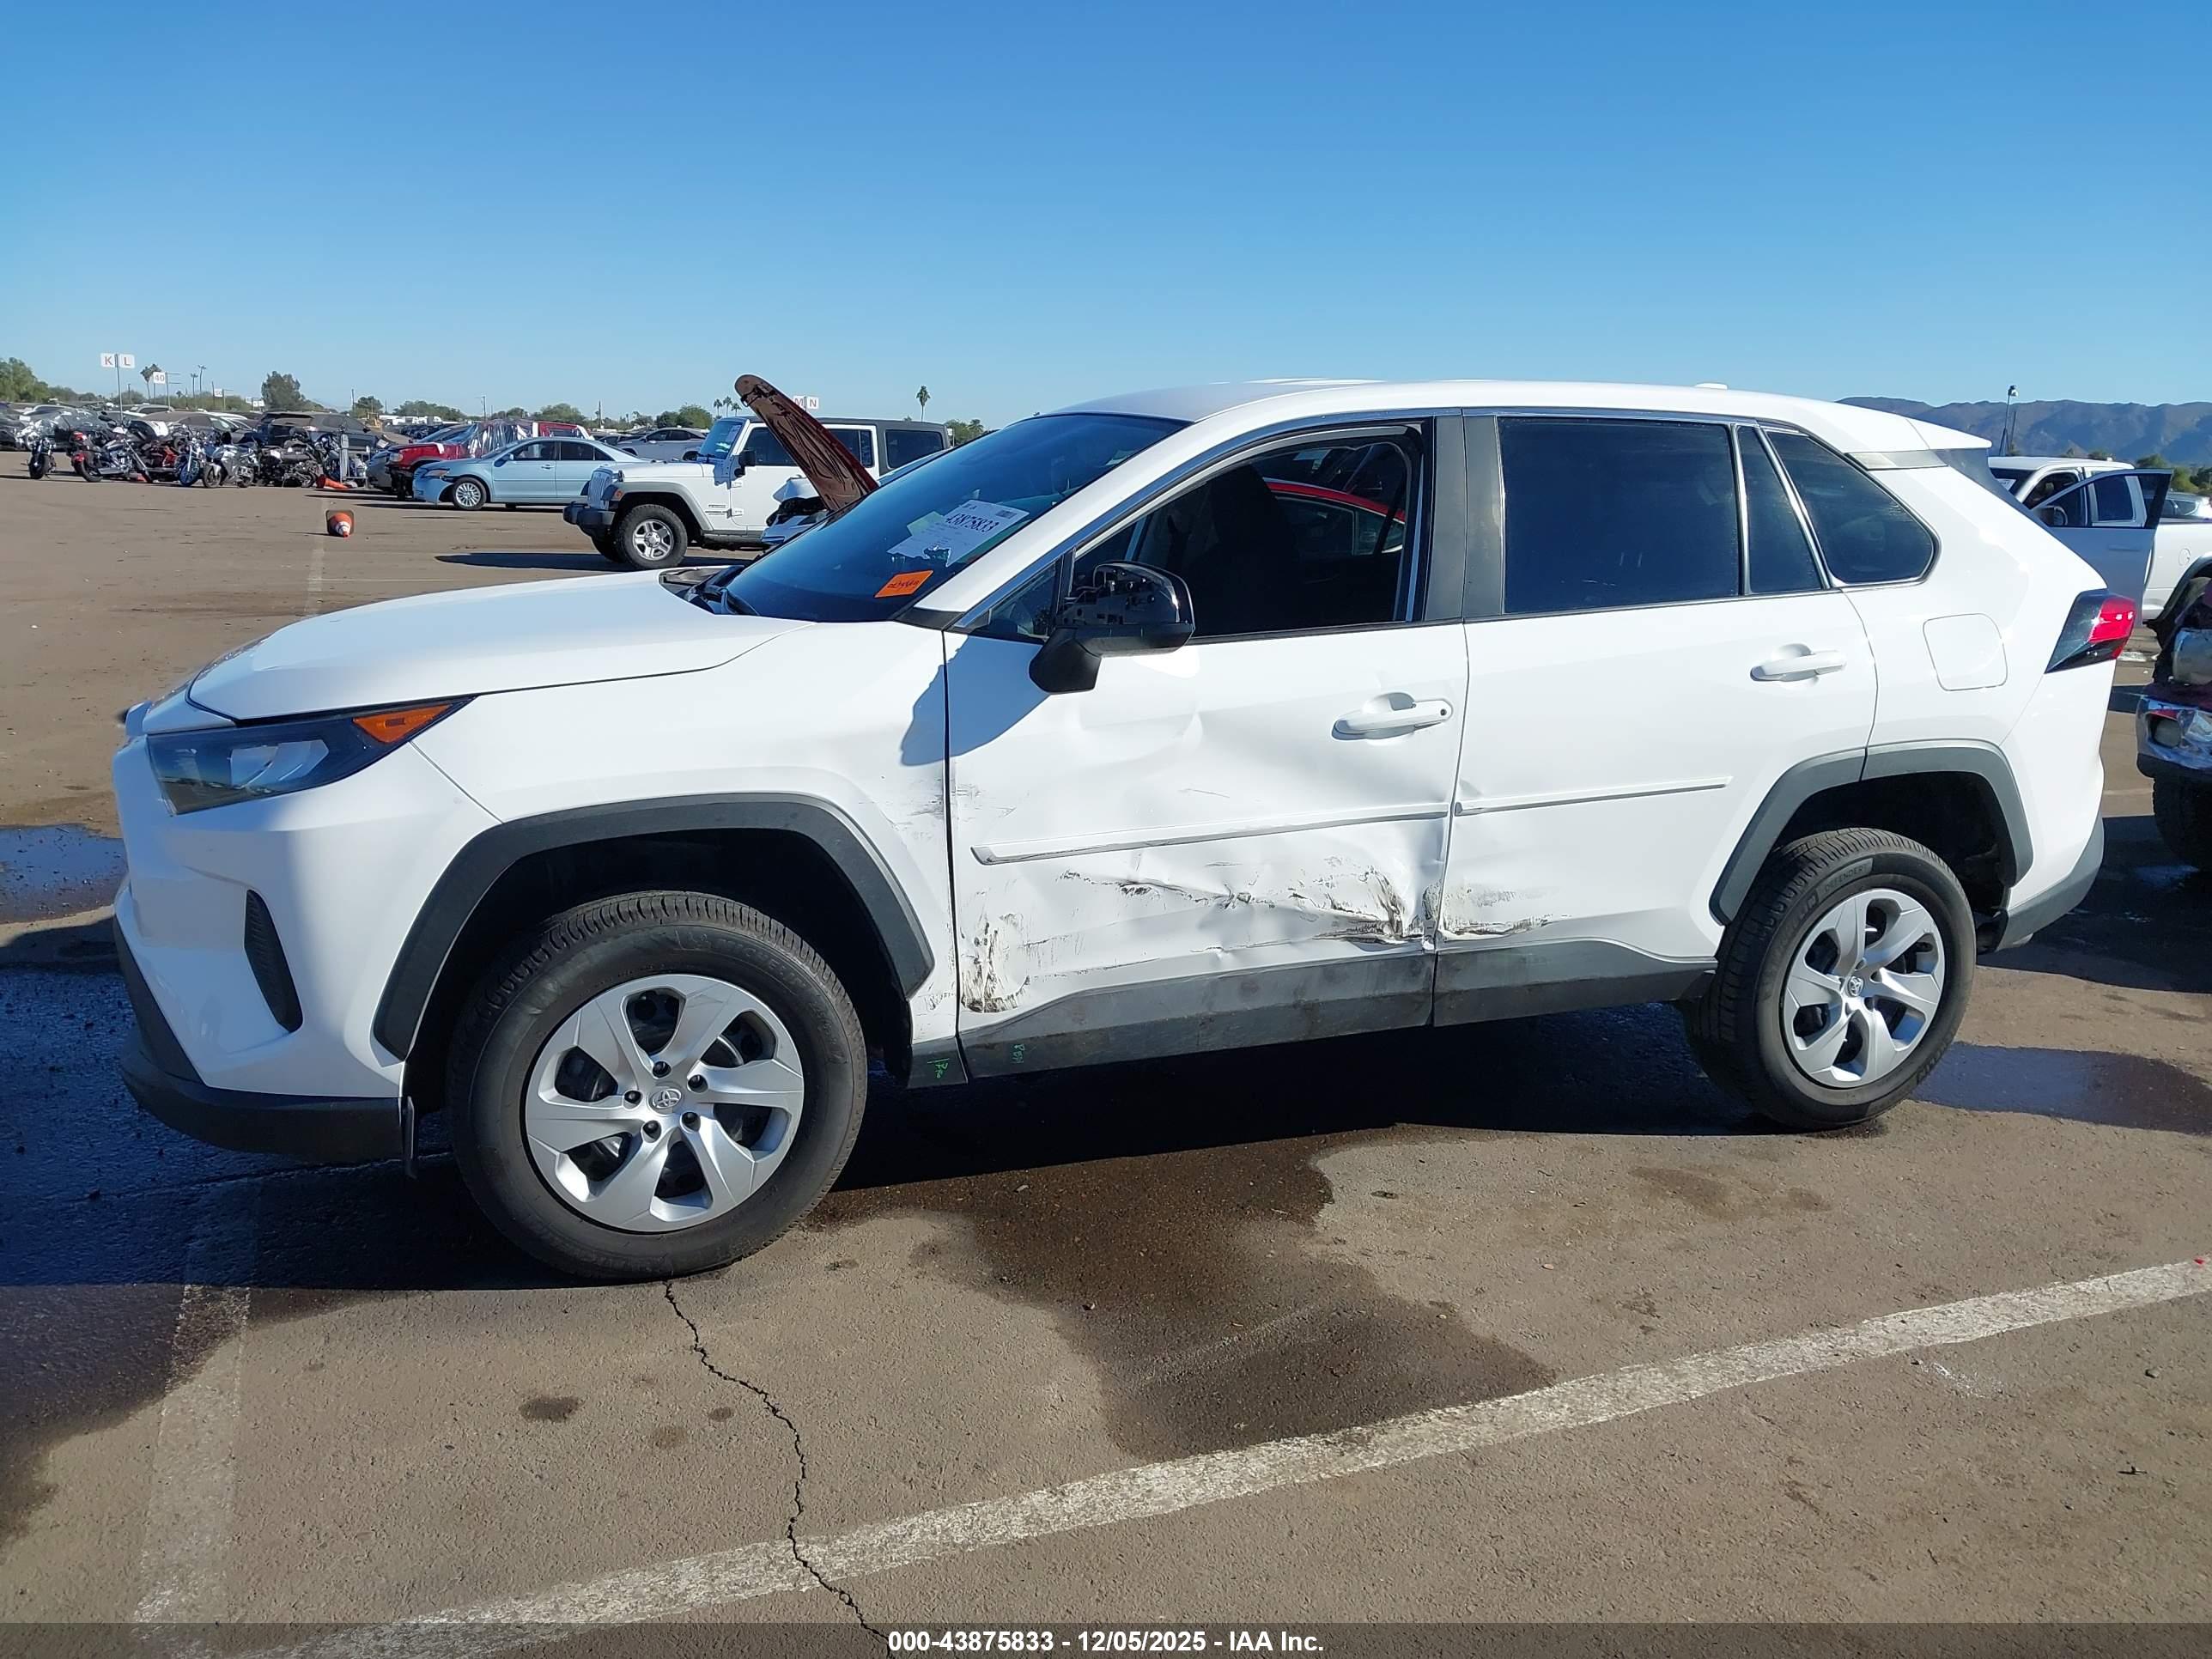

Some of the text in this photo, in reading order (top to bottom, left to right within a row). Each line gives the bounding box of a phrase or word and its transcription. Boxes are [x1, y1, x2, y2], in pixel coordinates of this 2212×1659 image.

[105, 356, 112, 366] K
[124, 356, 131, 366] L
[809, 398, 817, 408] N
[945, 513, 1000, 533] 43875833
